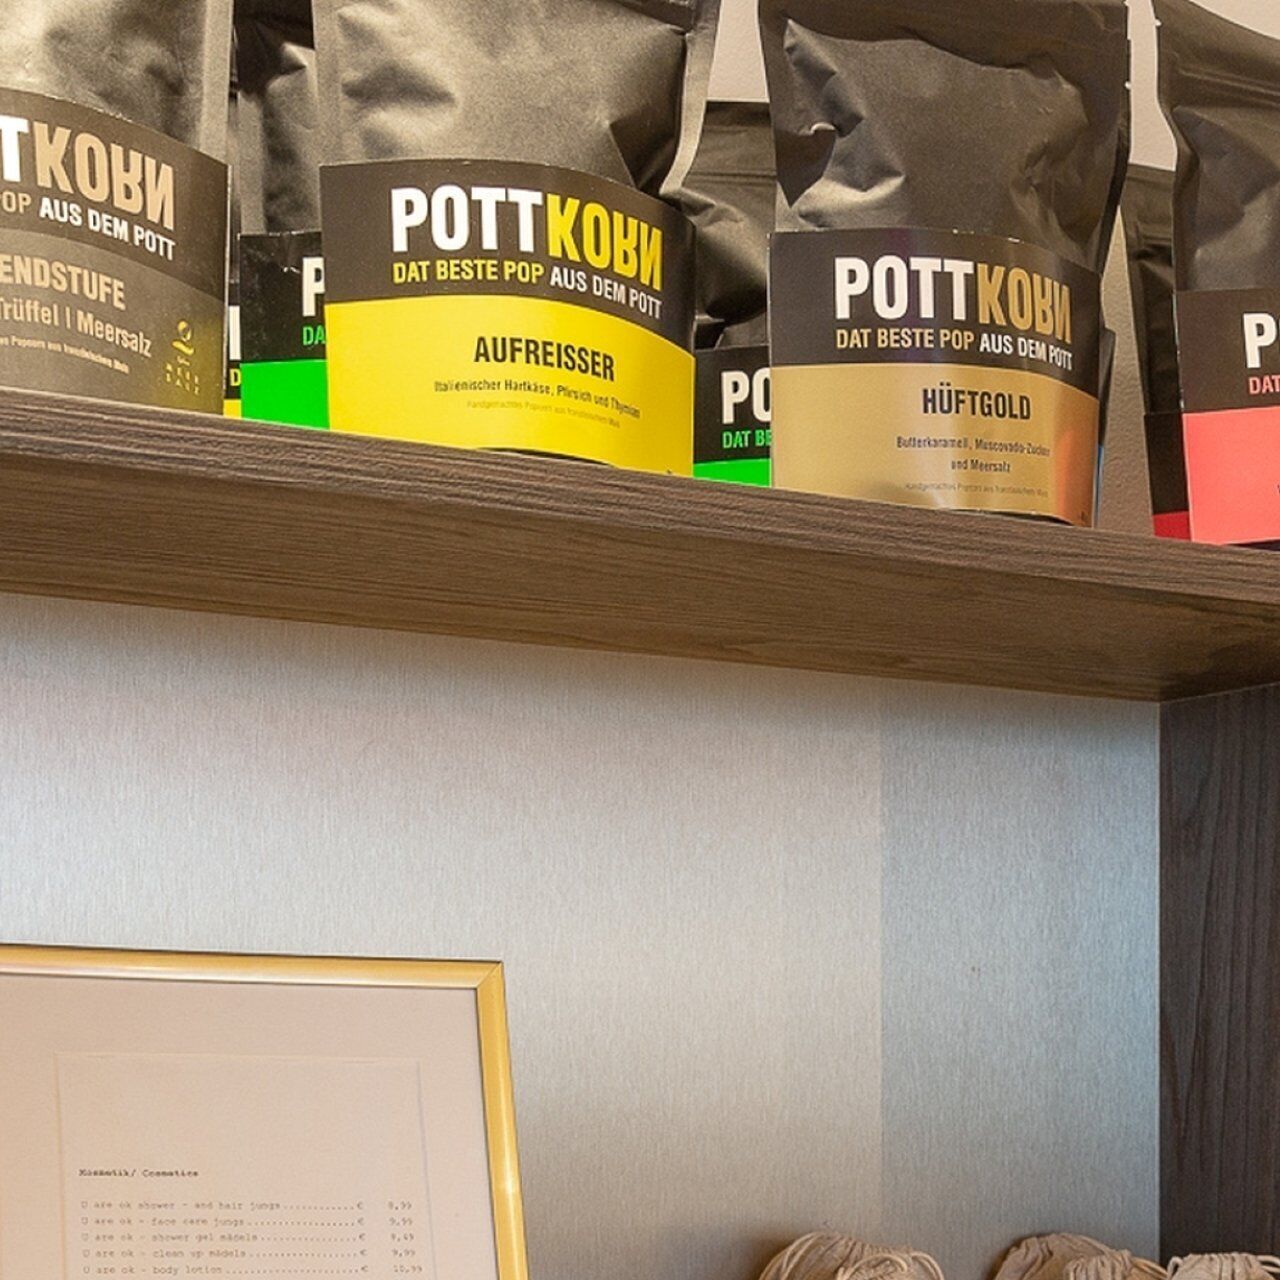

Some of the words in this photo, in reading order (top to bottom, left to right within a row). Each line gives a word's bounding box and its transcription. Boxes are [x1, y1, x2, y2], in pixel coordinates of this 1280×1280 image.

[39, 196, 82, 227] AUS
[88, 208, 129, 242] DEM
[133, 223, 177, 262] POTT
[390, 184, 663, 292] POTTKORN
[393, 261, 431, 284] DAT
[436, 260, 498, 281] BESTE
[504, 261, 544, 284] POP
[550, 266, 588, 292] AUS
[593, 275, 626, 304] DEM
[629, 288, 662, 320] POTT
[77, 310, 152, 359] Meersalz
[836, 329, 871, 349] DAT
[877, 328, 934, 349] BESTE
[940, 329, 974, 350] POP
[979, 334, 1013, 355] AUS
[1018, 337, 1046, 361] DEM
[1049, 345, 1072, 371] POTT
[473, 336, 615, 382] AUFREISSER
[923, 382, 1031, 420] HÜFTGOLD
[723, 430, 751, 449] DAT
